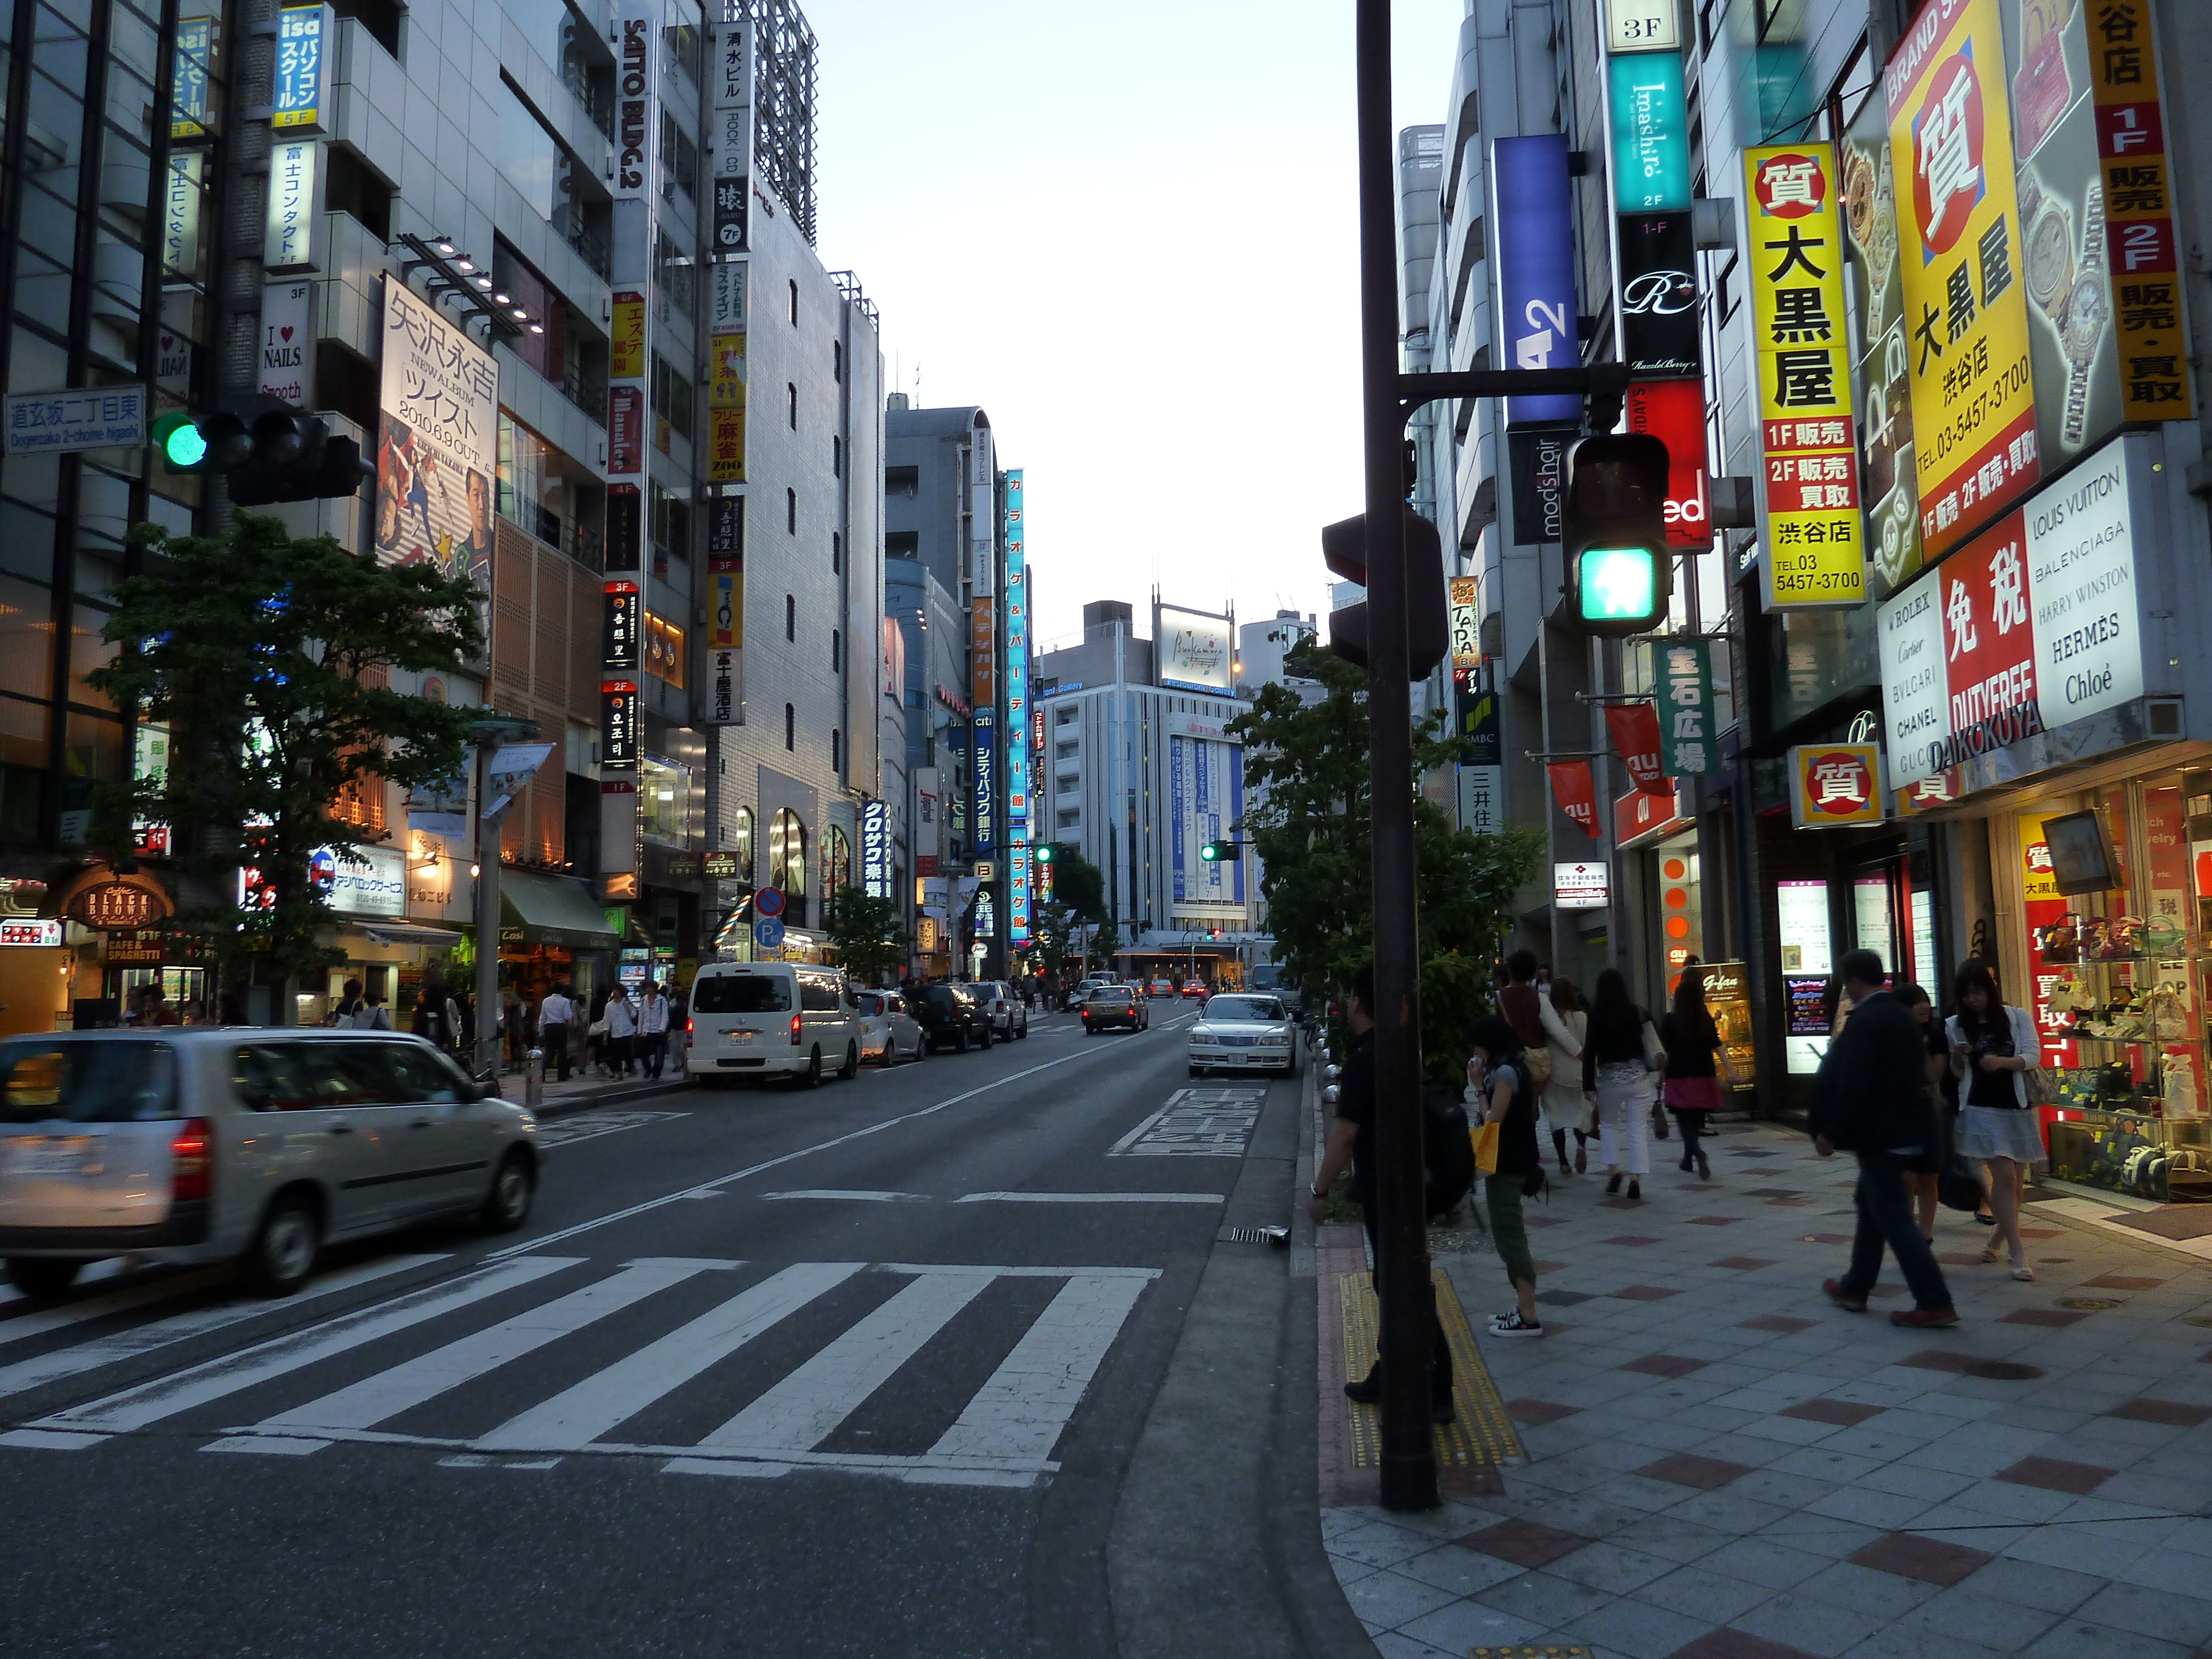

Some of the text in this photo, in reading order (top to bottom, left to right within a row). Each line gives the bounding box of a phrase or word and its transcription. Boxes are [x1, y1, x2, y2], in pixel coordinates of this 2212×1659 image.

[281, 15, 320, 37] isa
[1624, 18, 1661, 38] 3F
[2098, 3, 2141, 84] 谷店
[279, 42, 299, 108] スクール
[298, 41, 319, 106] パソコン
[622, 19, 646, 97] SAITO
[724, 32, 742, 98] 清水ビル
[1887, 9, 1939, 108] BRAND
[284, 112, 308, 125] 5F
[726, 113, 739, 146] ROCK
[1633, 82, 1667, 178] Imashiro
[2112, 108, 2147, 153] 1F
[726, 156, 738, 173] CD
[1919, 64, 1980, 242] 質
[281, 147, 303, 253] 富士コンタクト
[1644, 195, 1663, 206] 2F
[1762, 163, 1819, 210] 質
[2109, 166, 2162, 212] 販売
[723, 229, 738, 239] 7F
[1642, 222, 1668, 233] 1-F
[2123, 225, 2159, 270] 2F
[291, 288, 306, 299] 3F
[1914, 212, 2013, 378] 大黒屋
[627, 309, 643, 355] エステ
[1764, 225, 1837, 408] 大黒屋
[268, 326, 274, 346] I
[390, 290, 496, 405] 矢沢永吉
[264, 347, 301, 369] NAILS
[1943, 335, 1989, 408] 渋谷店
[411, 352, 476, 408] NEW ALBUM
[12, 394, 138, 429] 道玄坂二丁目東
[405, 369, 477, 439] ツイスト
[713, 410, 743, 422] フリー
[399, 400, 481, 467] 2010.6.9 OUT
[716, 422, 738, 460] 麻雀
[1770, 421, 1845, 446] 1F 販売
[712, 461, 742, 472] ZOO
[1771, 457, 1848, 482] 2F 販売
[617, 485, 633, 494] 4F
[1801, 484, 1850, 509] 買取
[1922, 516, 1935, 539] 1F
[1937, 490, 1959, 533] 販売
[1963, 478, 1975, 510] 2F
[2033, 466, 2121, 541] LOUIS VUITTON
[1778, 520, 1851, 545] 渋谷店
[719, 561, 732, 570] 3F
[2035, 520, 2125, 584] BALENCIAGA
[616, 583, 629, 591] 3F
[1777, 571, 1860, 591] 5457-3700
[2039, 563, 2128, 625] HARRY WINSTON
[1895, 591, 1931, 629] ROLEX
[1946, 541, 2026, 664] 免税
[613, 613, 625, 656] 吾照里
[1452, 606, 1474, 654] TAPA
[1897, 637, 1924, 666] Cartier
[614, 682, 628, 691] 2F
[1893, 665, 1936, 703] BVLGARI
[2065, 663, 2112, 705] Chloé
[975, 717, 993, 727] citi
[1667, 646, 1706, 773] 宝石広場
[1897, 706, 1937, 739] CHANEL
[611, 713, 624, 756] 오조리
[1465, 733, 1494, 743] SMBC
[1933, 698, 2045, 773] DAIKOKUYA
[977, 747, 991, 842] シティバンク銀行
[1814, 761, 1866, 805] 質
[1637, 796, 1650, 823] au
[864, 802, 883, 898] クロサワ楽器
[89, 894, 149, 905] BLACK
[1013, 839, 1026, 929] カラオケ館
[89, 904, 149, 915] BROWN
[3, 926, 42, 936] ブラック
[108, 941, 143, 950] CAFE &
[762, 925, 774, 943] P
[769, 935, 779, 943] 40
[108, 950, 161, 960] SPAGHETTI
